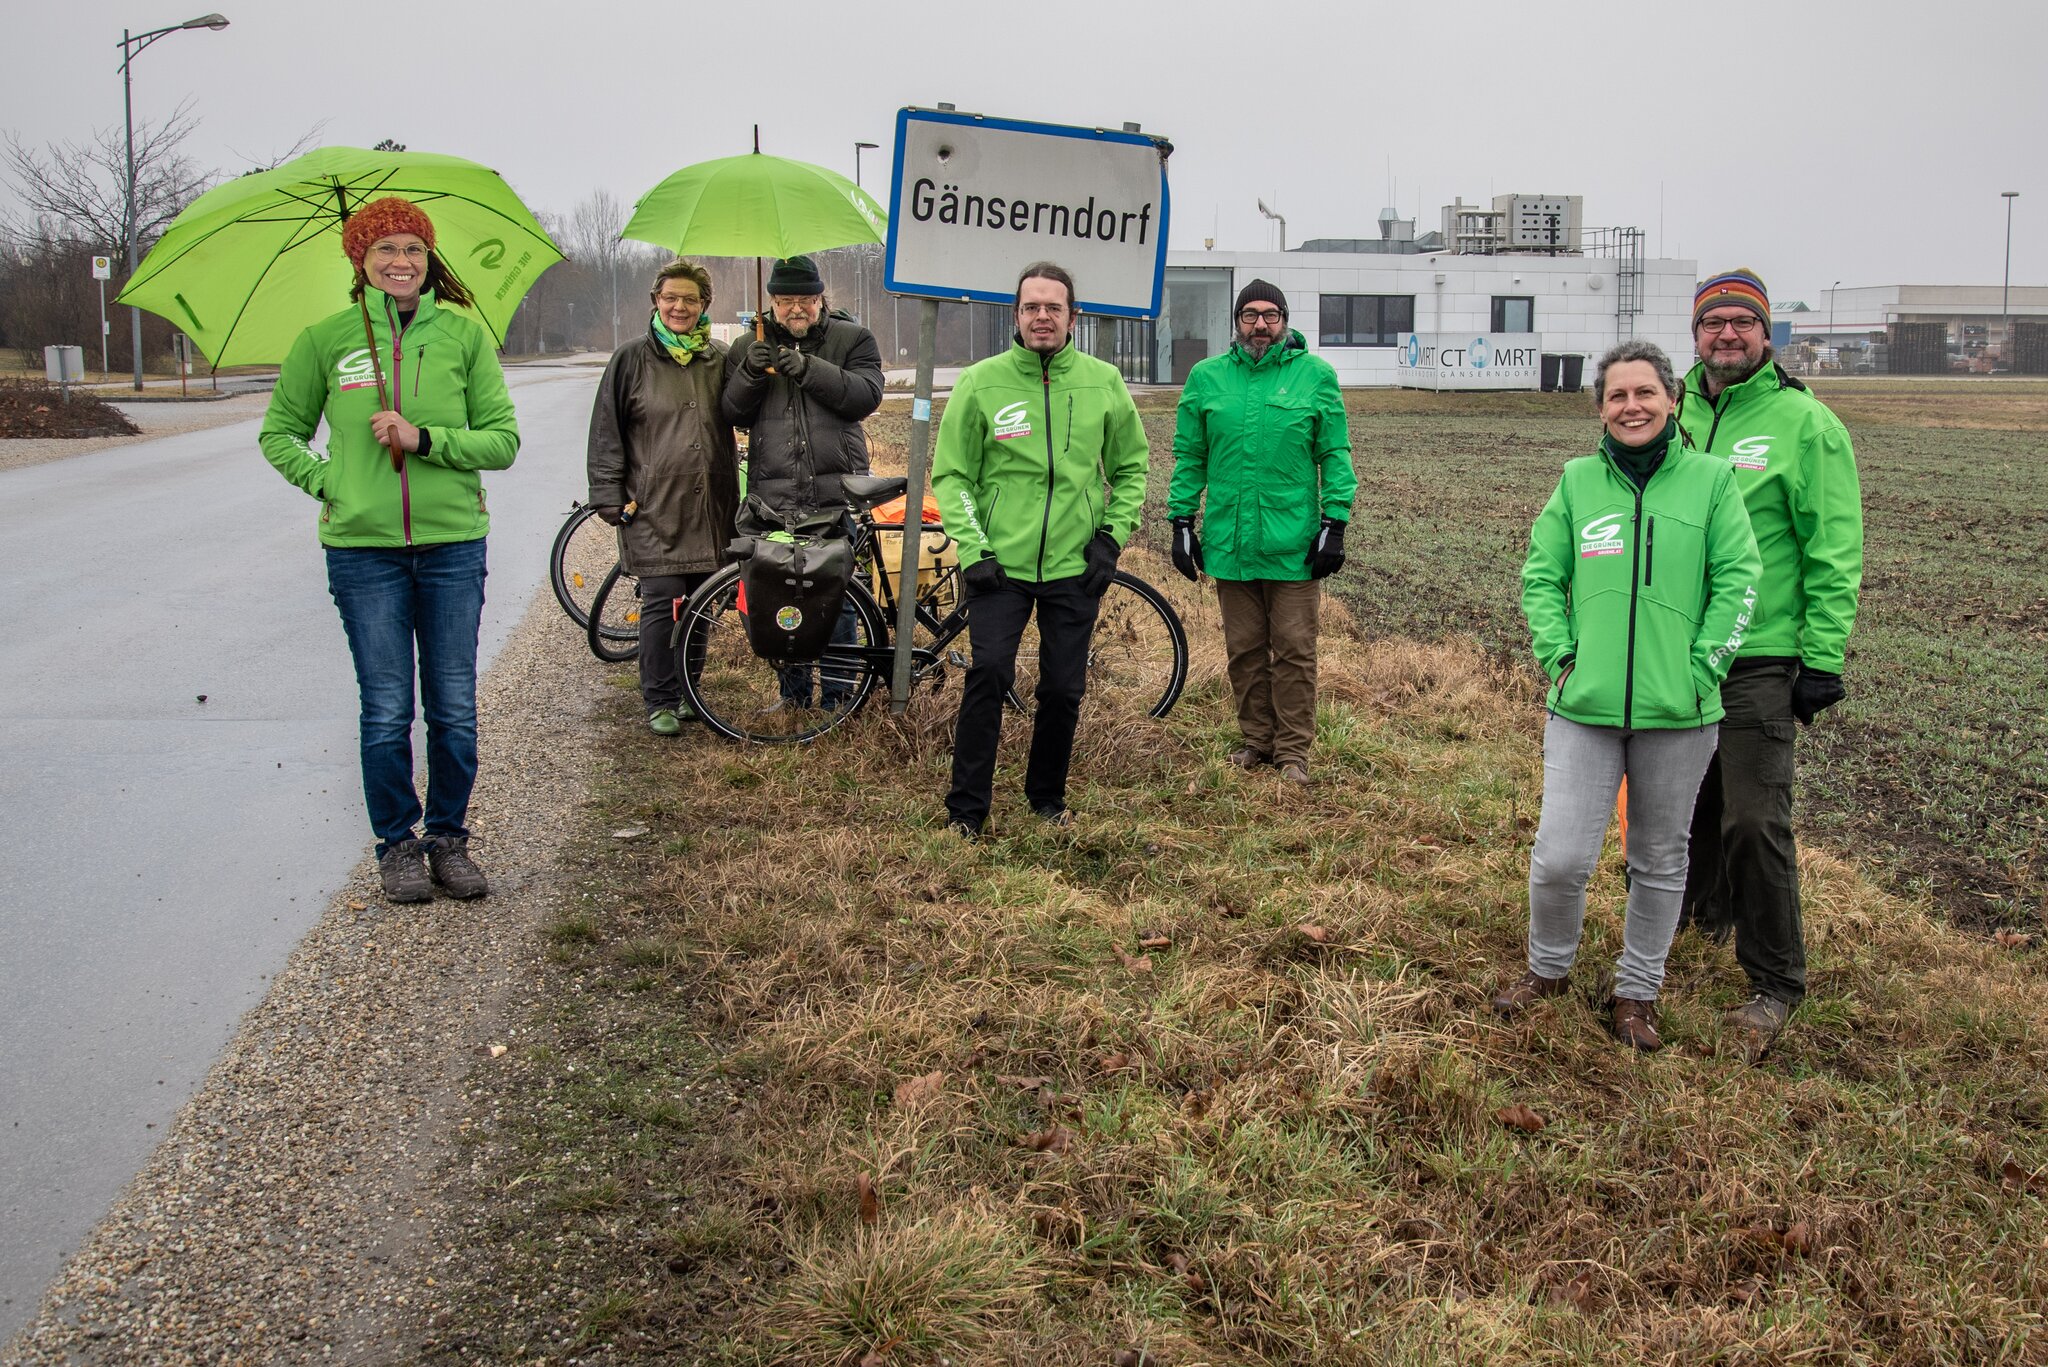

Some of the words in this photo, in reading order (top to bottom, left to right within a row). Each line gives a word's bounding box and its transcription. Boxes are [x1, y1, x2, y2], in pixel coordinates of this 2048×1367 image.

[911, 177, 1151, 245] Gänserndorf
[1398, 346, 1409, 365] CT
[1418, 347, 1436, 366] MRT
[1440, 349, 1466, 367] CT
[1494, 348, 1537, 366] MRT
[1006, 424, 1030, 432] GRÜNEN
[1593, 541, 1622, 549] GRÜNEN
